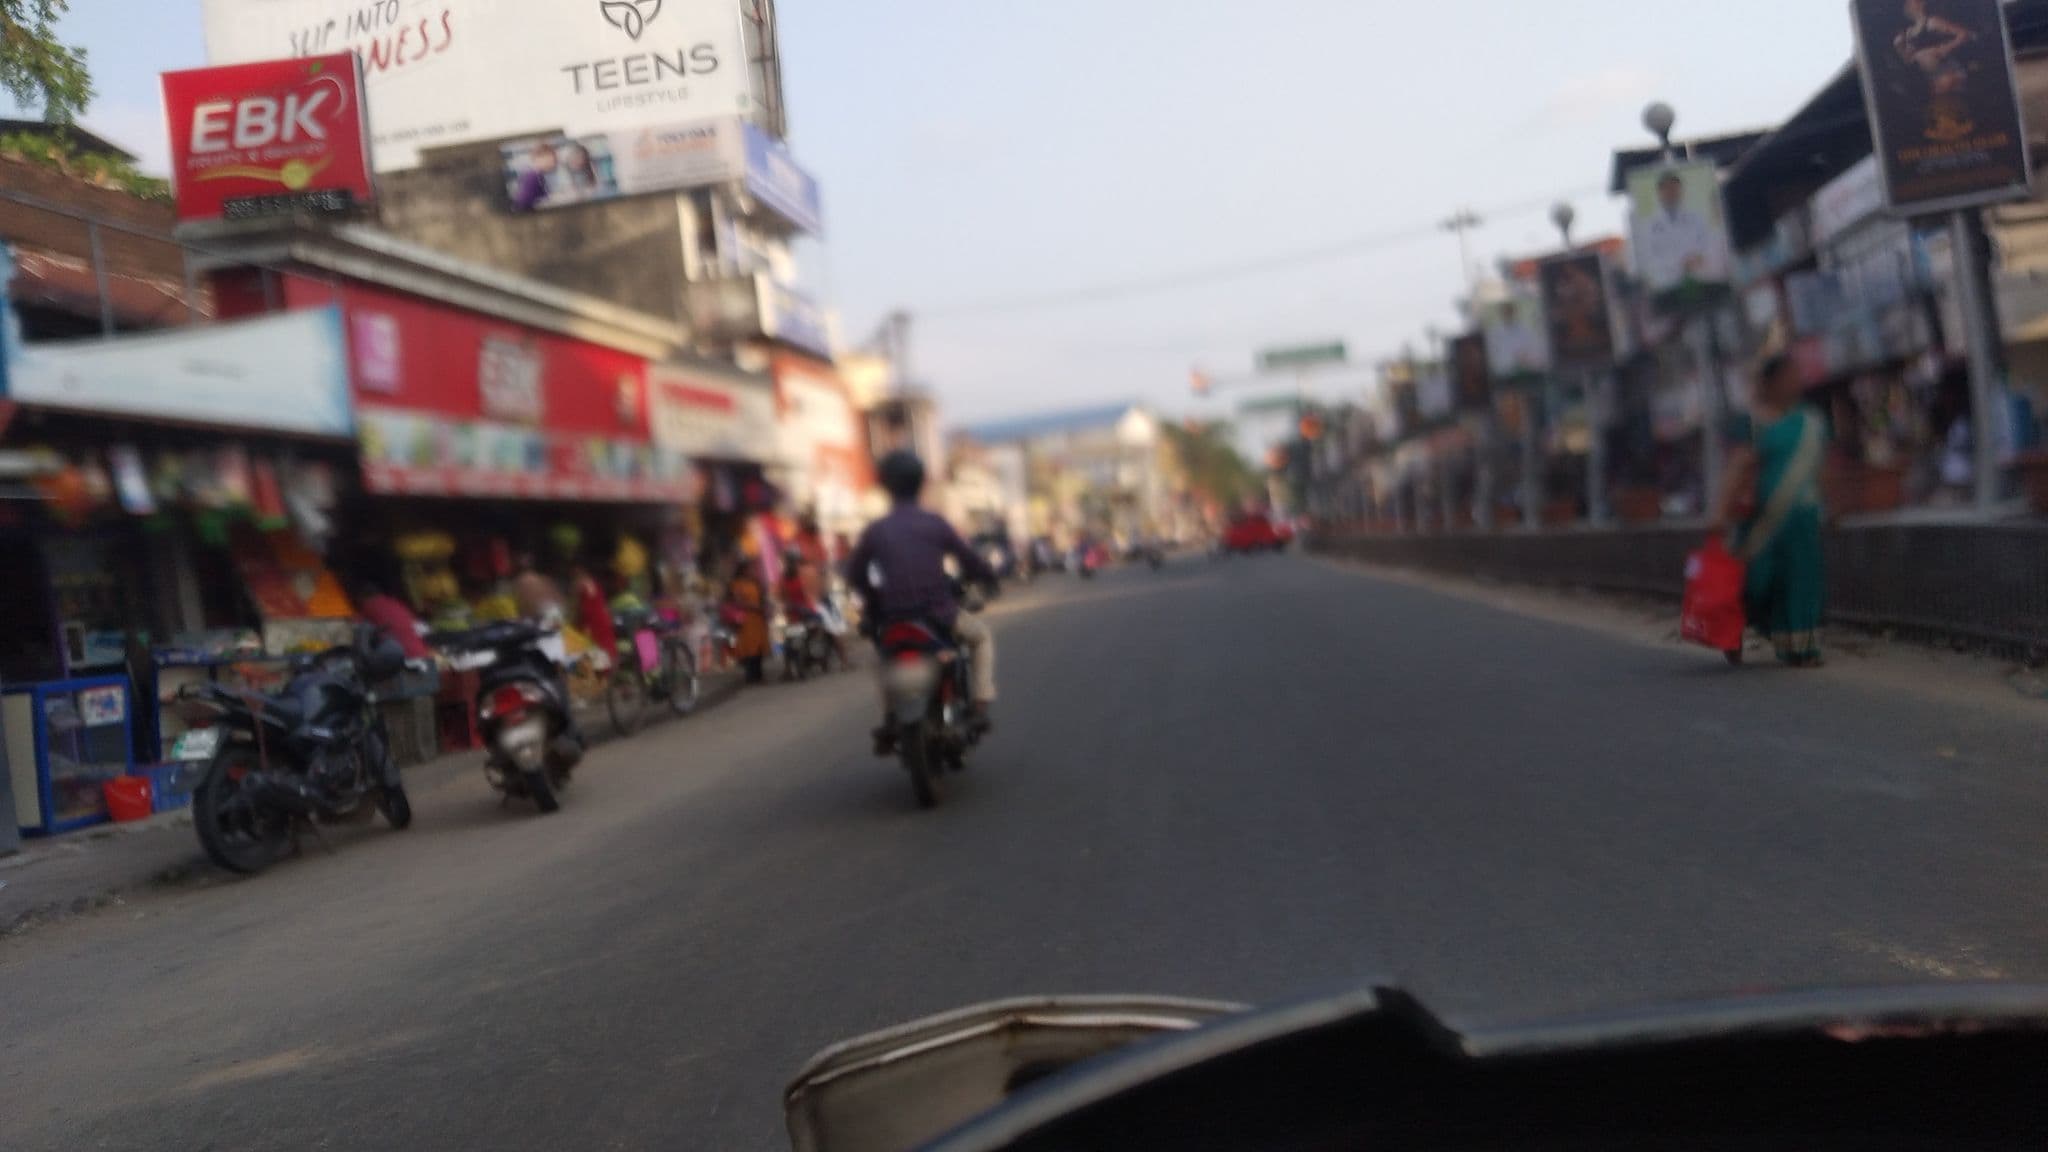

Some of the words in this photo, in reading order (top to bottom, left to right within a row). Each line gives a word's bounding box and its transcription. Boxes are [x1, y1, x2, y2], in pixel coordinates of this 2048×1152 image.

[345, 0, 399, 38] INTO
[357, 9, 451, 78] NESS
[560, 43, 718, 94] TEENS
[189, 90, 330, 154] EBK
